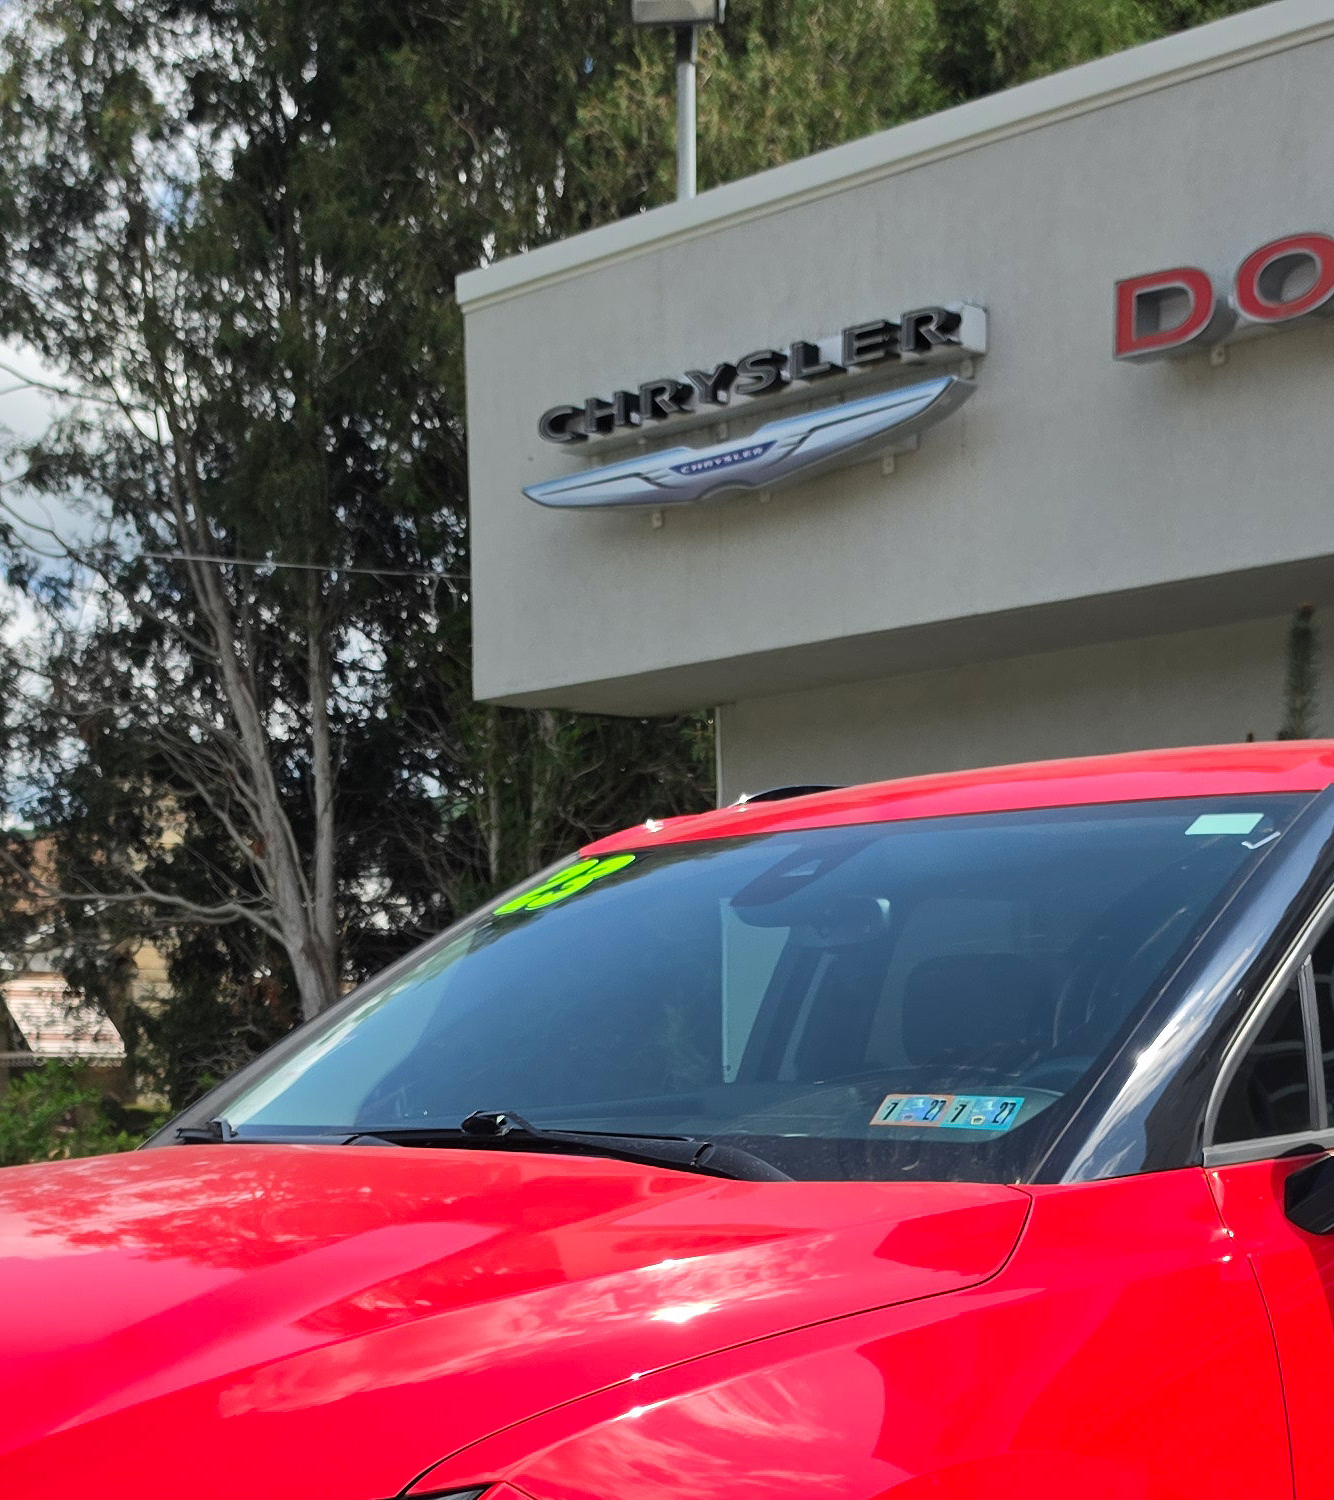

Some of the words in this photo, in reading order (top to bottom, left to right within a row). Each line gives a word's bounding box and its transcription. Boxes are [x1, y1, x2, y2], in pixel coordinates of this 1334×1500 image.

[537, 305, 962, 443] CHRYSLER
[922, 1100, 947, 1122] 27
[991, 1102, 1017, 1124] 27
